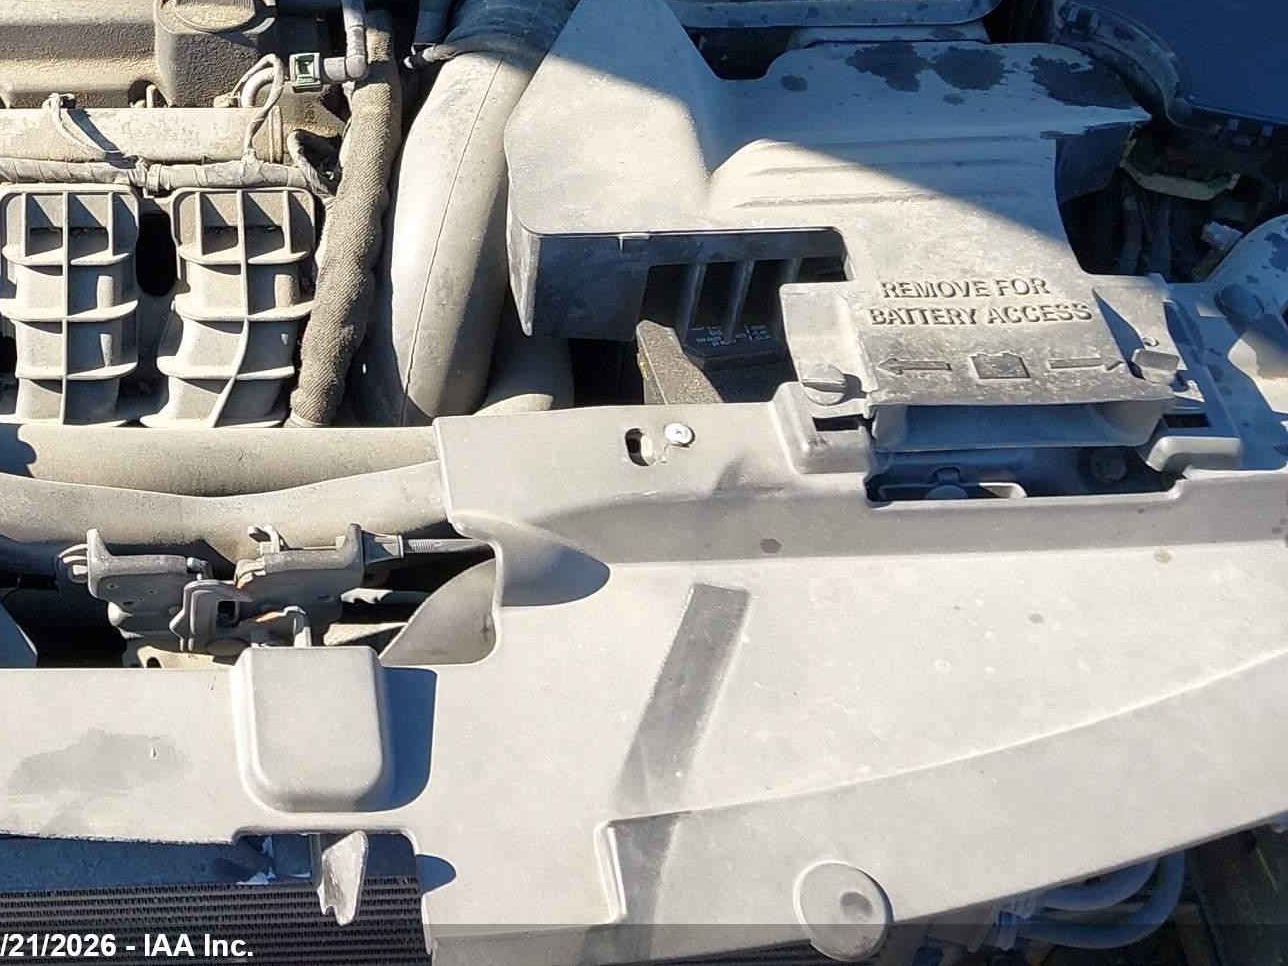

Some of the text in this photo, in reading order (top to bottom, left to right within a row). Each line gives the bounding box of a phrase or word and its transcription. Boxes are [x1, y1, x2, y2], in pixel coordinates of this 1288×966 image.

[881, 278, 1050, 298] REMOVE FOR
[869, 302, 1093, 325] BATTERY ACCESS
